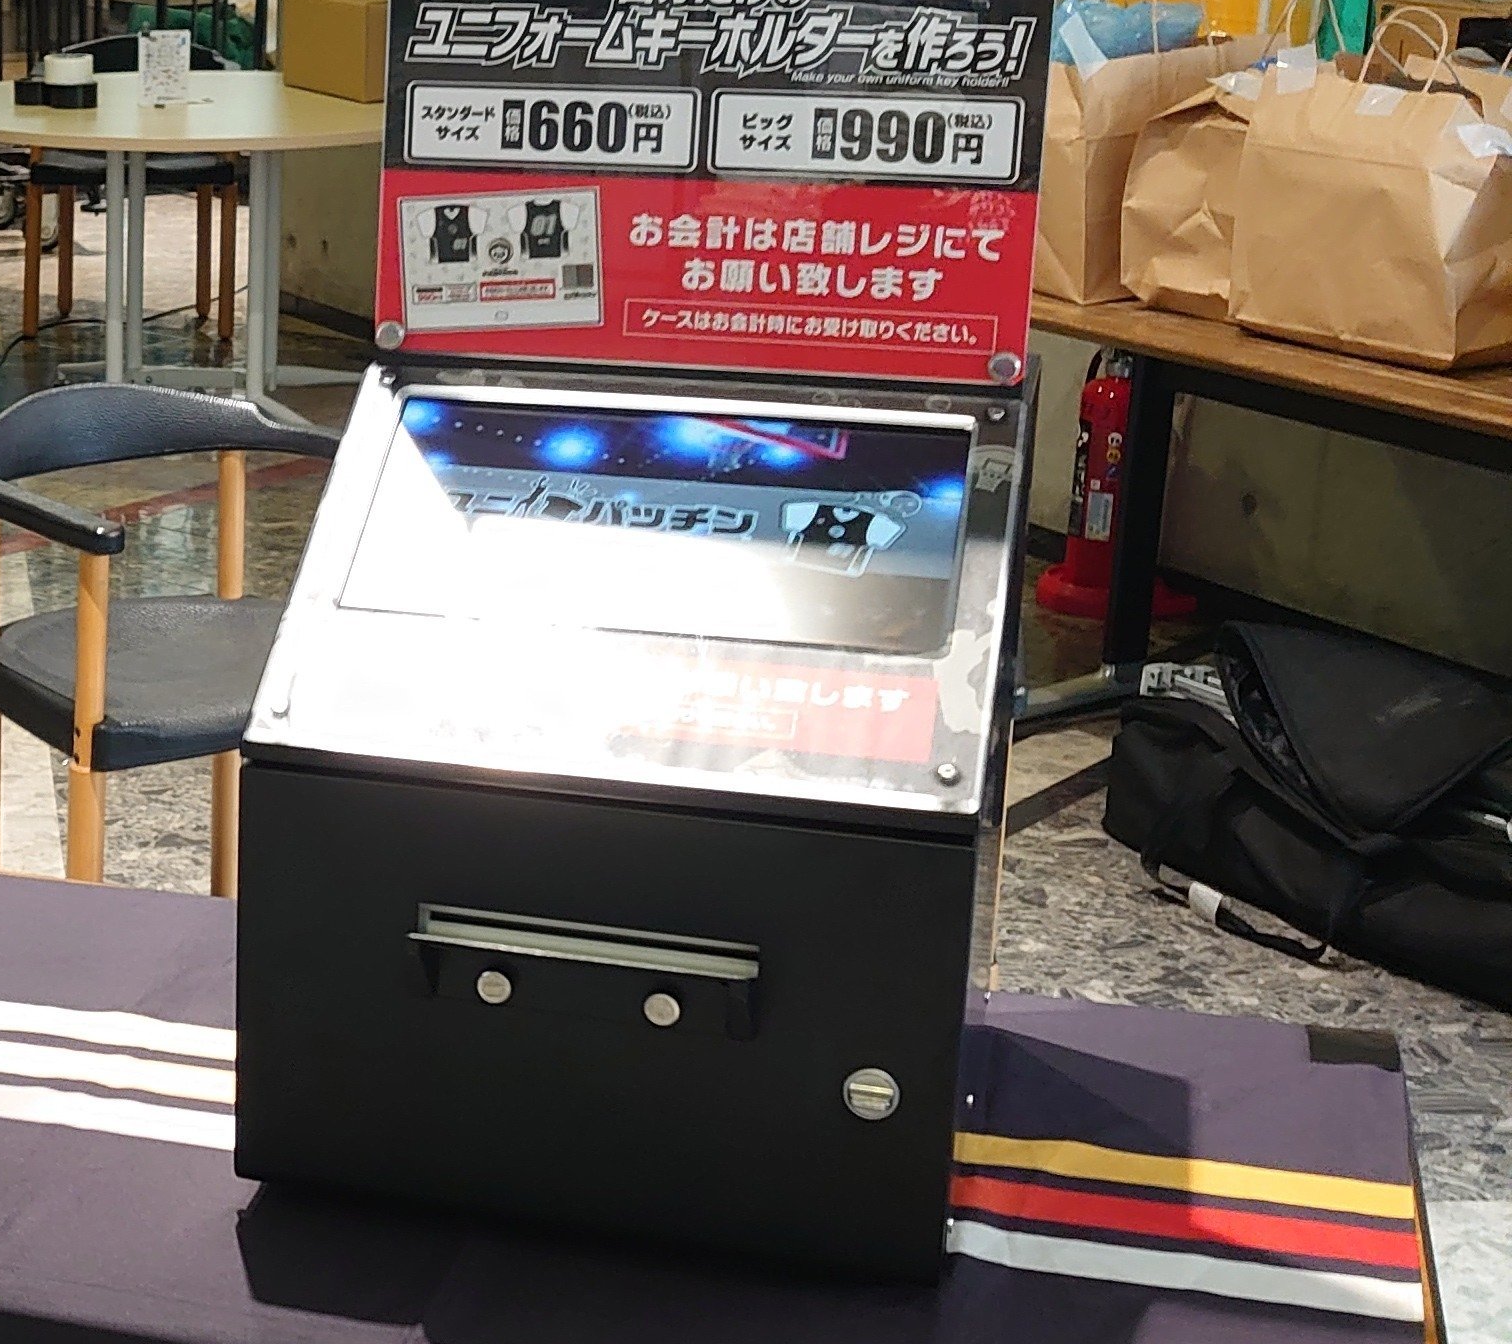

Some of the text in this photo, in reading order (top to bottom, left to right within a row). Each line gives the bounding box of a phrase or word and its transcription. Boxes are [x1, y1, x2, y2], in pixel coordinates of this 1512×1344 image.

[791, 71, 823, 83] Make
[826, 73, 854, 85] your
[421, 104, 496, 122] スタンダード
[741, 112, 793, 130] ビッグ
[435, 124, 480, 142] サイズ
[739, 133, 792, 152] サイズ
[628, 213, 1006, 262] お会計は店舗レジにて
[681, 256, 945, 302] お願い致します
[641, 306, 979, 346] ケースはお会計時にお受け取りください。
